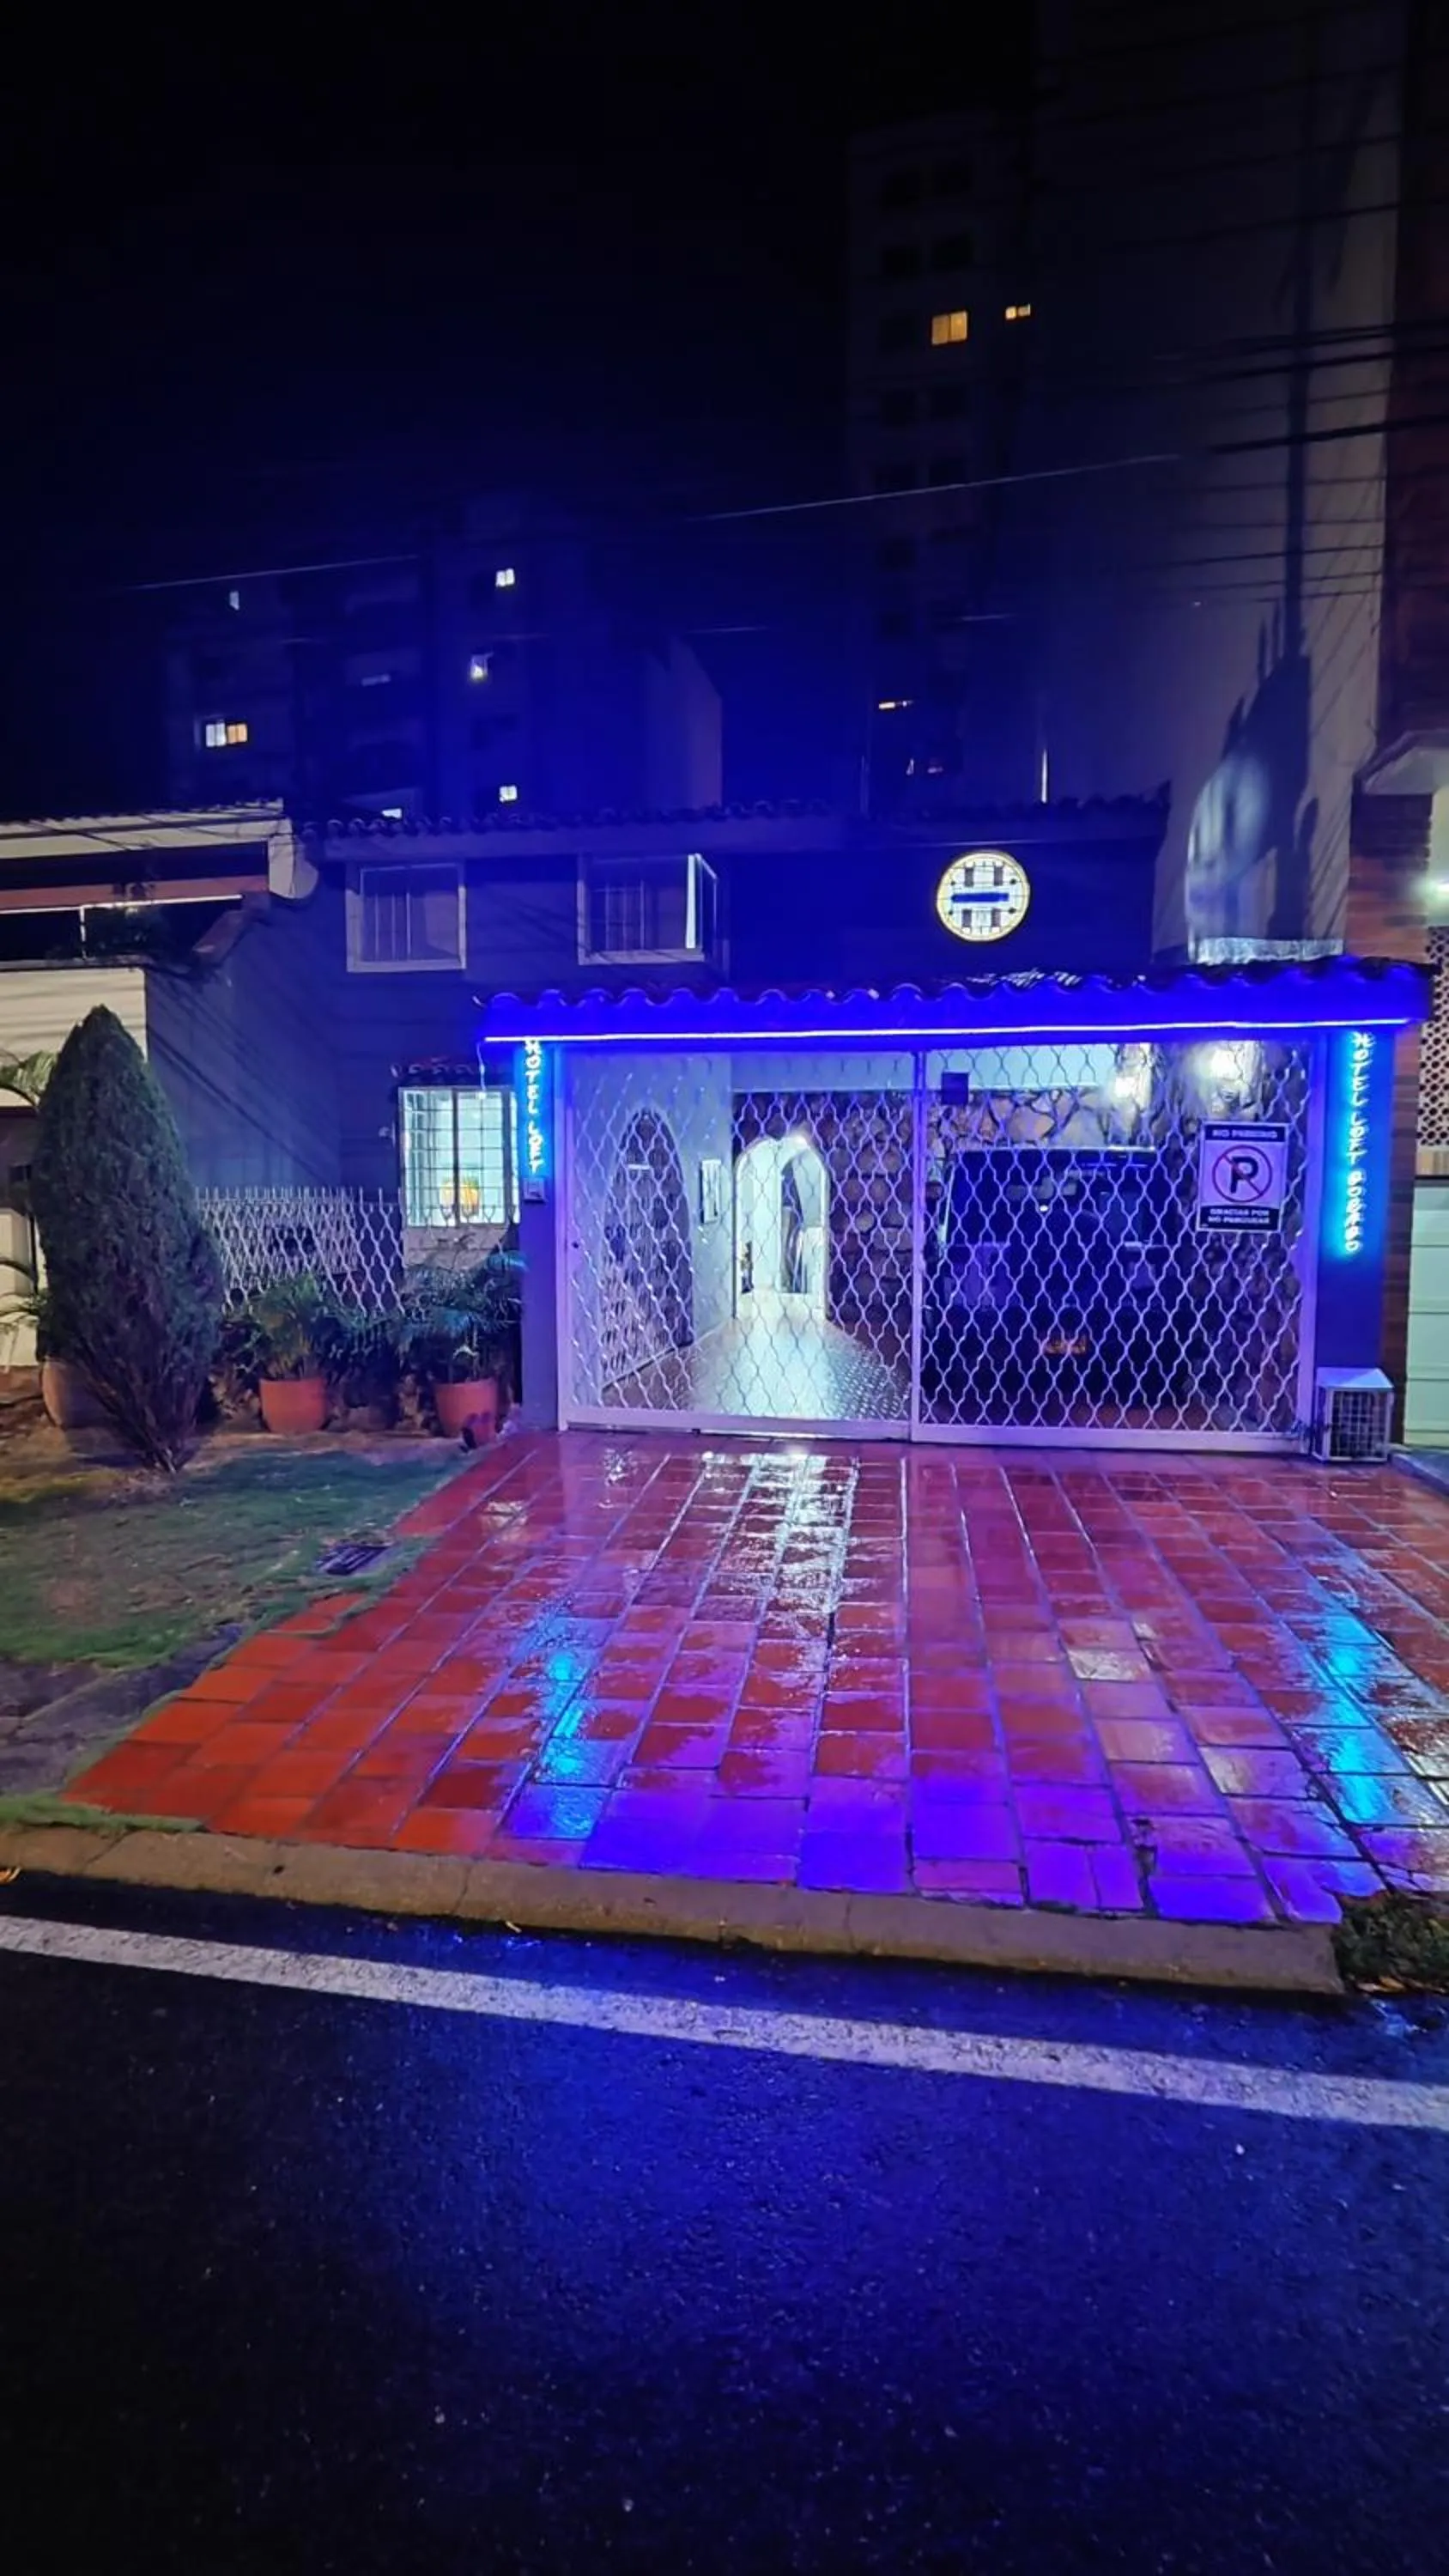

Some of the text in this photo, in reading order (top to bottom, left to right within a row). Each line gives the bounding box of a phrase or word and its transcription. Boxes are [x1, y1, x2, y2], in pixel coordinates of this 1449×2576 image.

[1350, 1031, 1375, 1107] HOTEL
[524, 1039, 544, 1175] HOTEL LOFT
[1212, 1129, 1230, 1138] NO
[1345, 1111, 1368, 1165] LOFT
